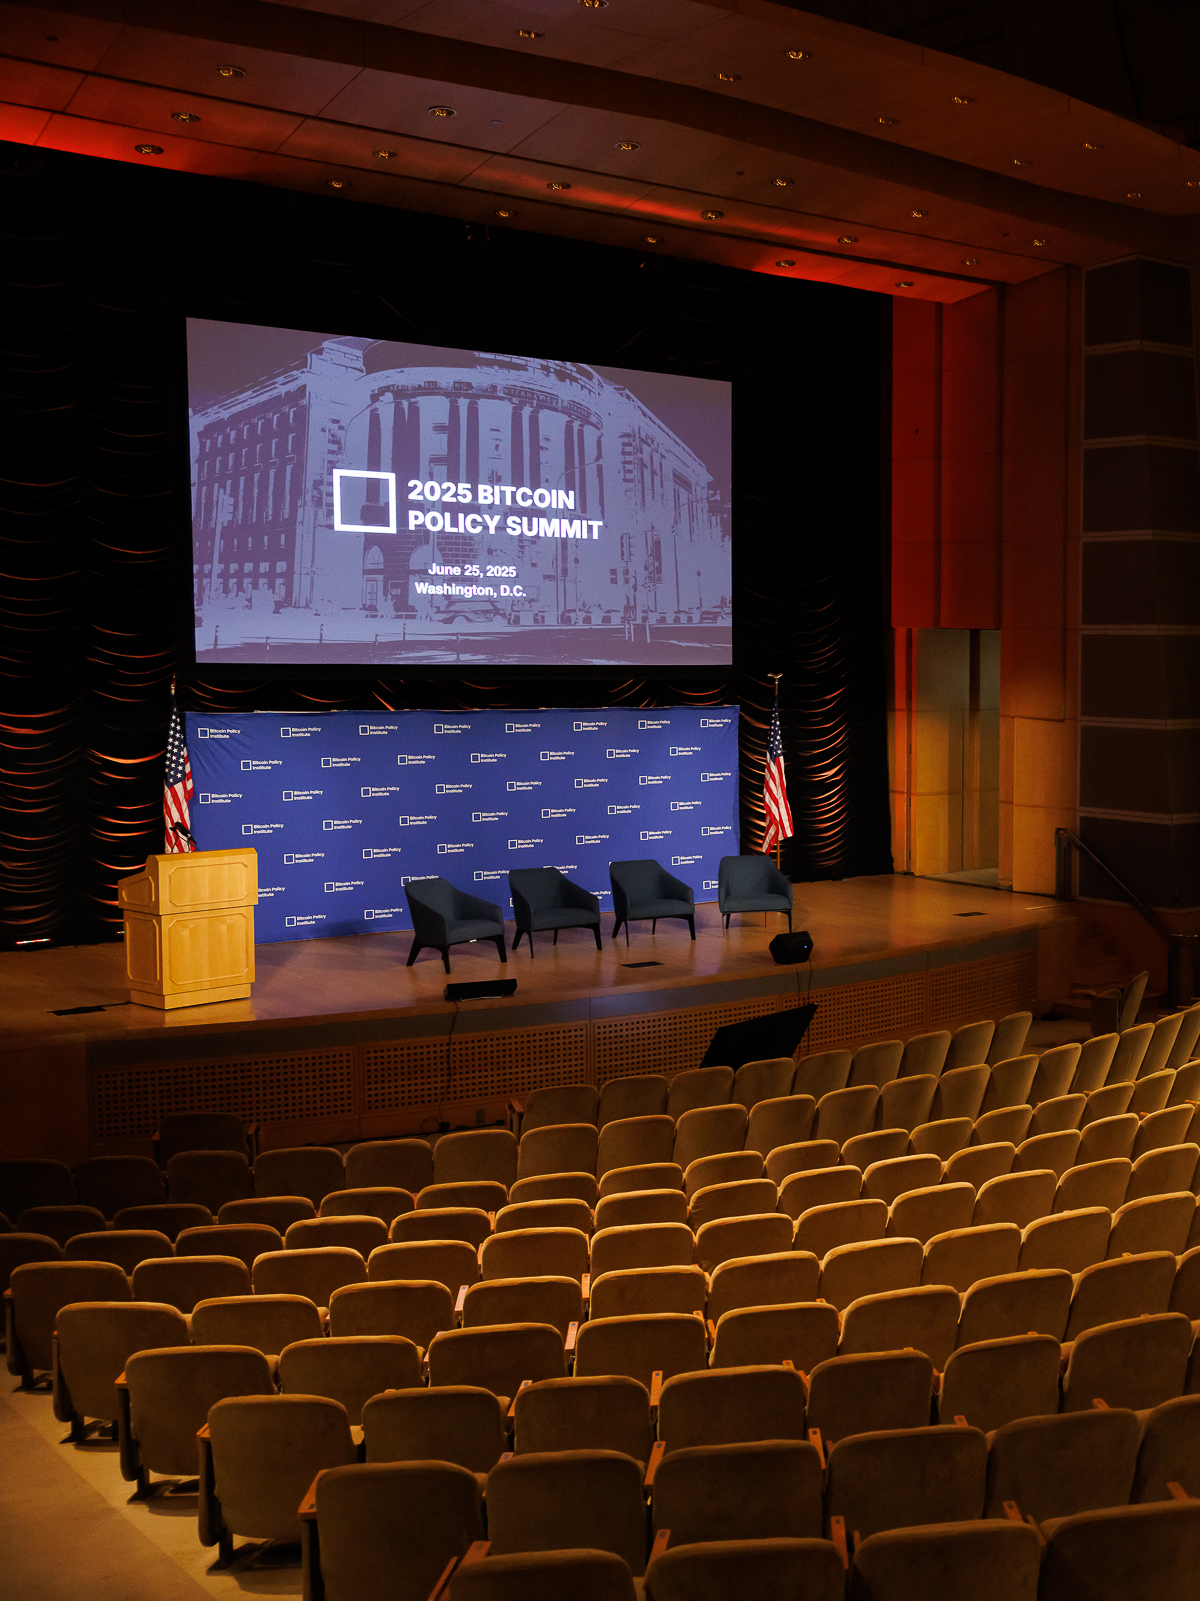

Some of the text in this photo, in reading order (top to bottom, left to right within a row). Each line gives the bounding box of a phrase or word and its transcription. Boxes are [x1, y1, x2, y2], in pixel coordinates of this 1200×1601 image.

[407, 479, 575, 510] 2025 BITCOIN
[408, 510, 603, 540] POLICY SUMMIT
[428, 563, 517, 578] June 25, 2025
[414, 582, 498, 598] Washington,
[500, 585, 526, 597] D.C.
